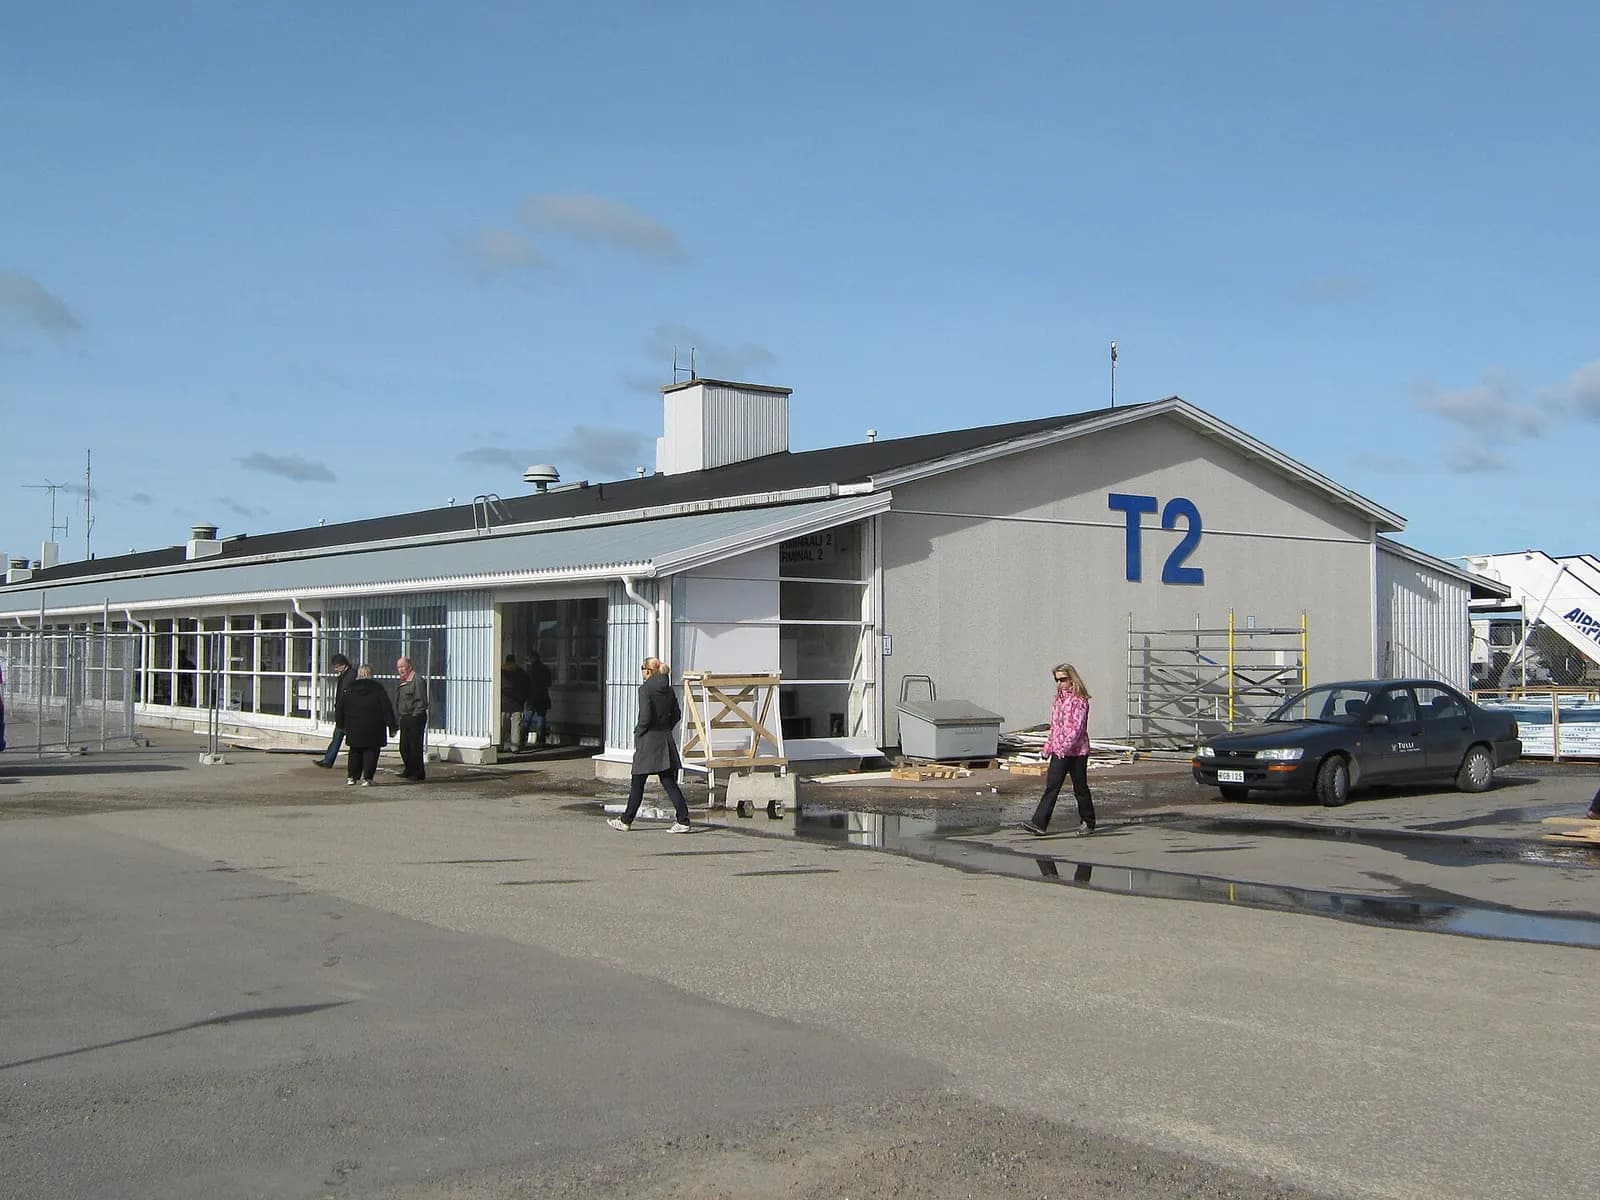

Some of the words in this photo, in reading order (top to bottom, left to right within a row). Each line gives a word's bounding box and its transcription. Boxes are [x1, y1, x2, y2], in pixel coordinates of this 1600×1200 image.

[826, 534, 832, 546] 2
[1108, 492, 1205, 586] T2
[816, 548, 824, 560] 2
